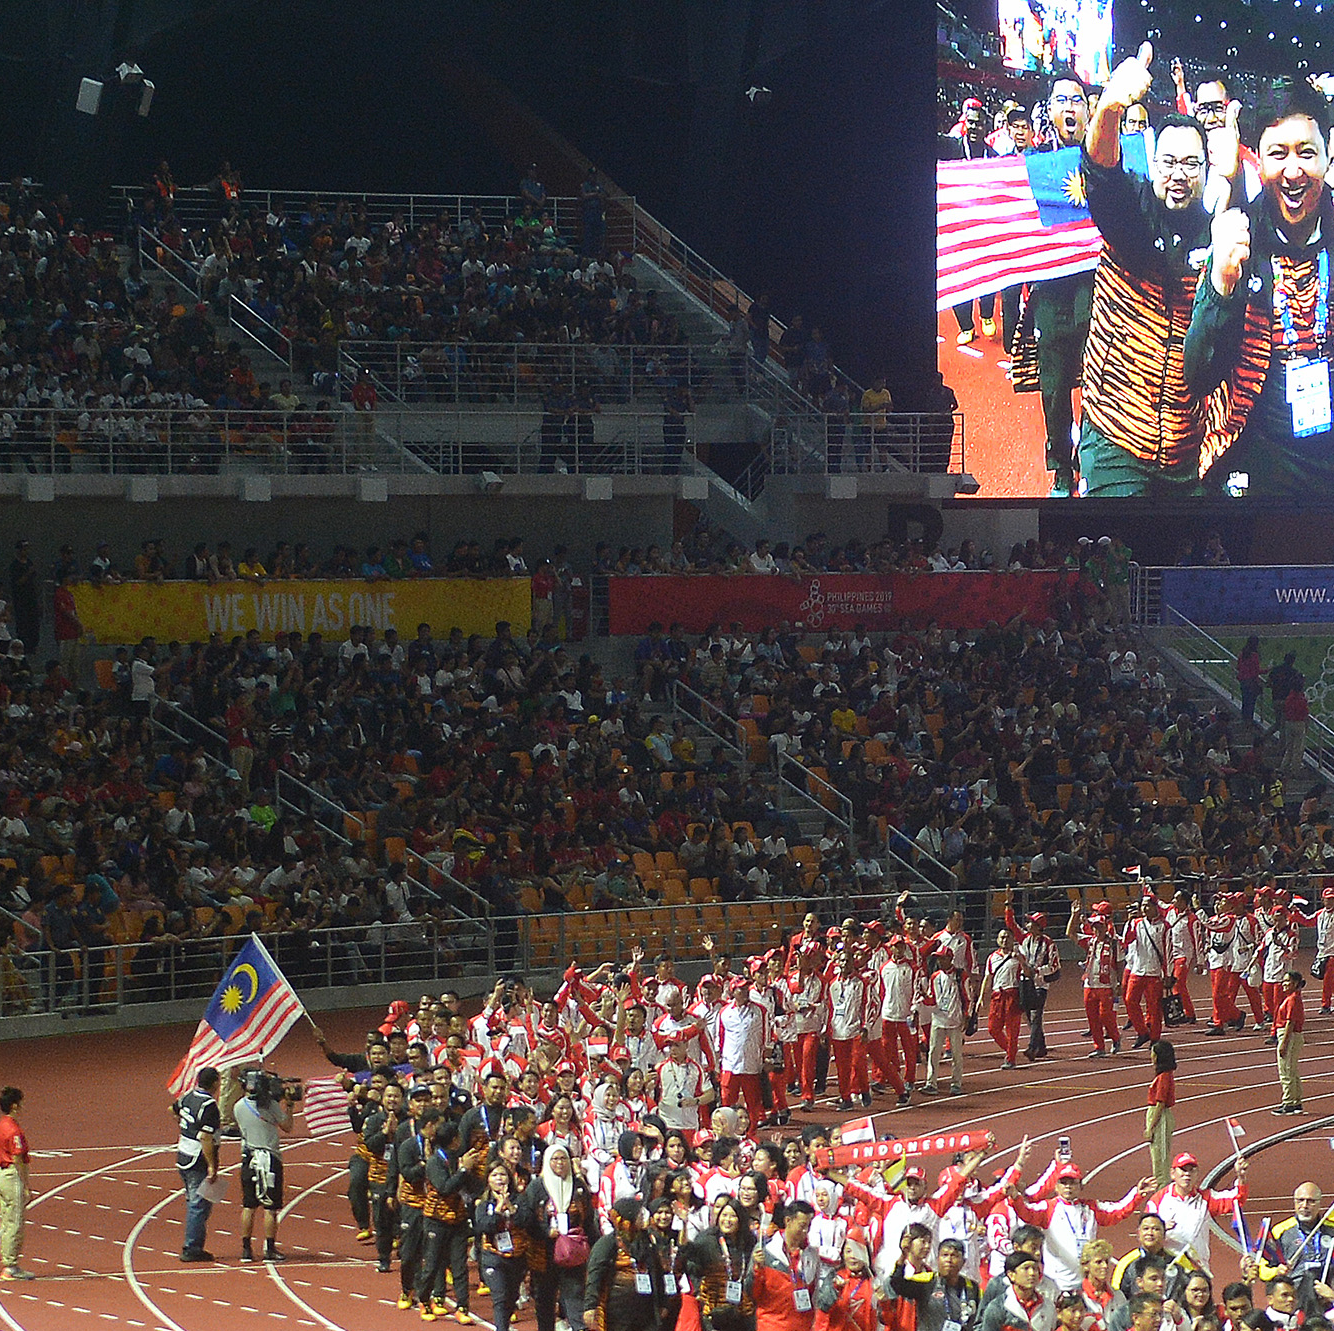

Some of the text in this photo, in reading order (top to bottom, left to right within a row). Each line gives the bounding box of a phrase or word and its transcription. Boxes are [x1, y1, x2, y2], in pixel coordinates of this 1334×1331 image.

[204, 592, 397, 632] WE WIN AS ONE
[852, 1135, 970, 1159] INDONESIA
